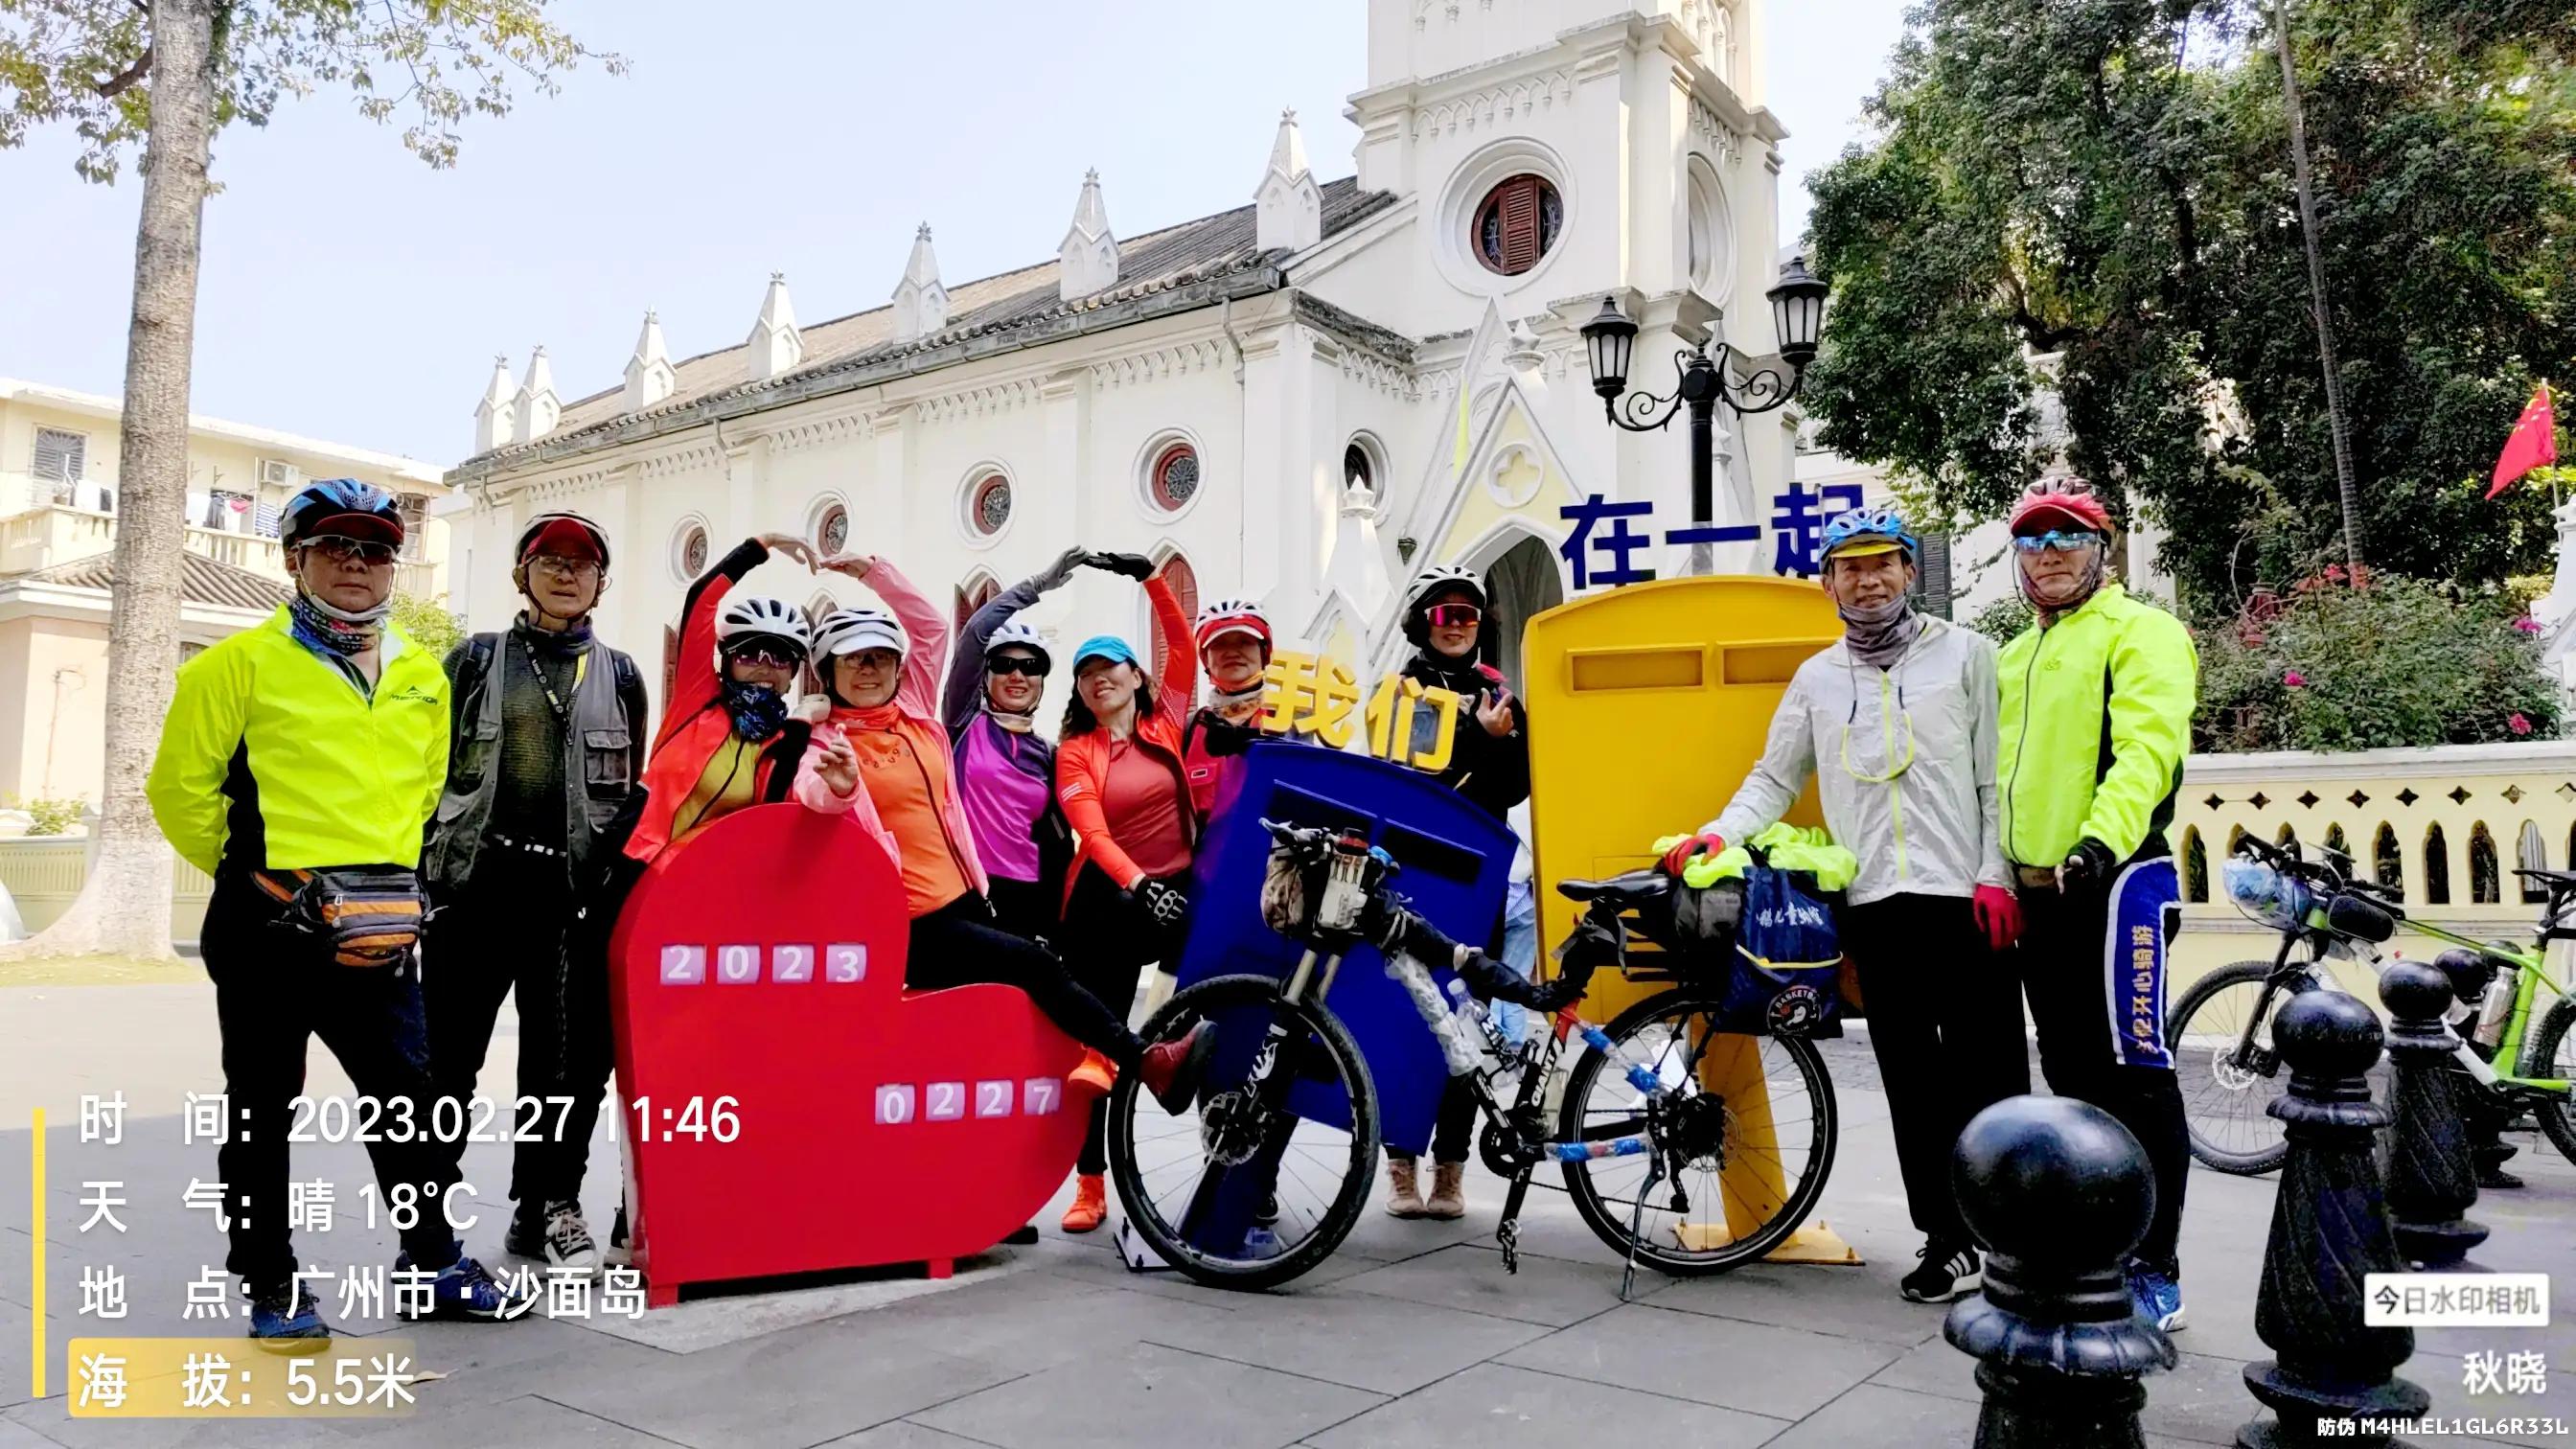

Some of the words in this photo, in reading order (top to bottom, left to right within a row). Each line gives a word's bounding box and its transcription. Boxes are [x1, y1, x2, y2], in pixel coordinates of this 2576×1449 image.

[1560, 482, 1864, 589] 在一起
[1261, 650, 1459, 771] 我们
[667, 945, 861, 983] 2023
[883, 1084, 1052, 1124] 0227
[1530, 1048, 1556, 1108] GIANT
